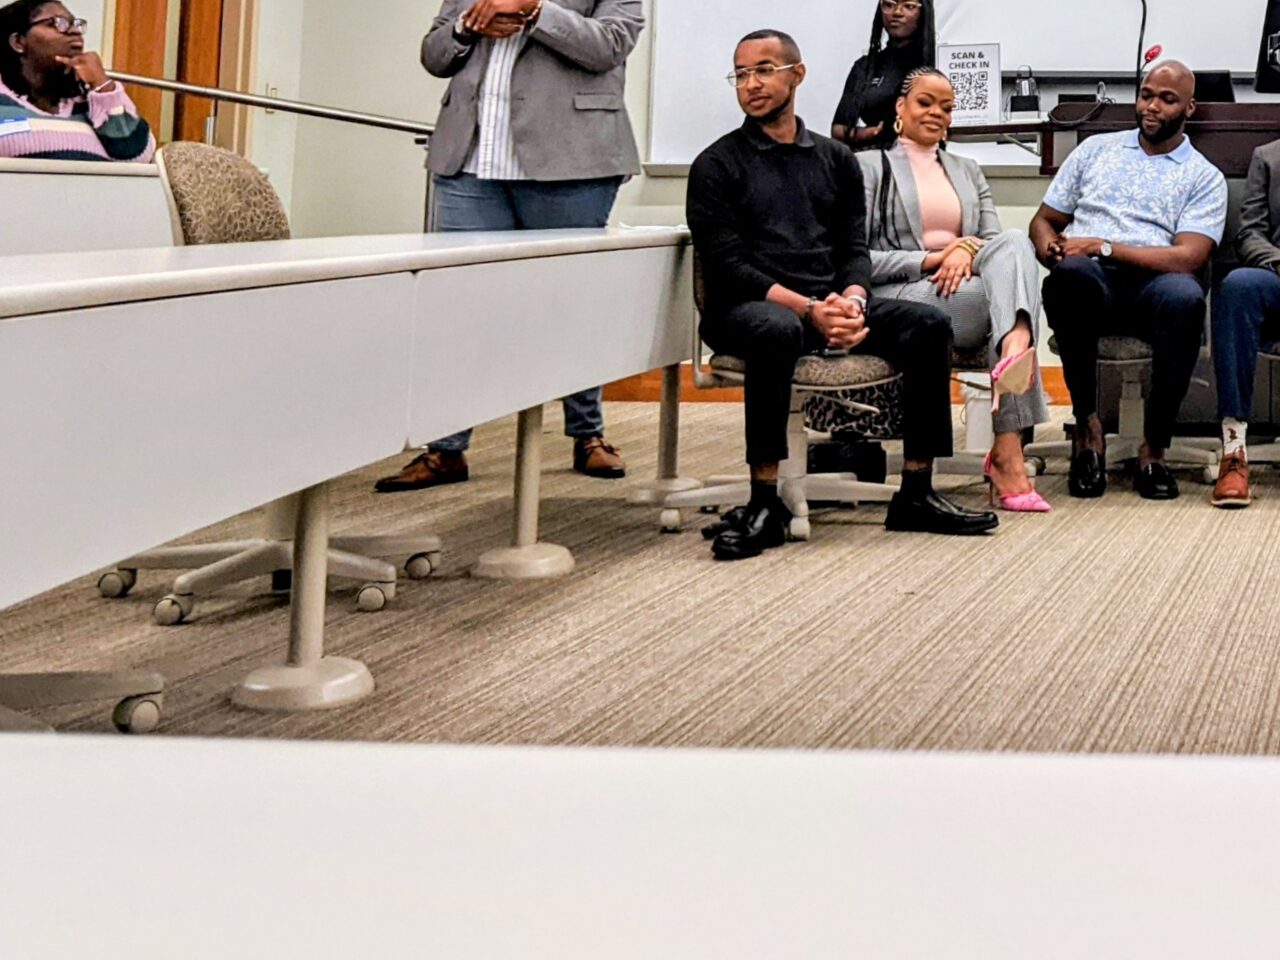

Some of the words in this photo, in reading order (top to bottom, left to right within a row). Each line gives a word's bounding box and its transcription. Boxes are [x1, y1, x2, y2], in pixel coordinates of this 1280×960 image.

[951, 51, 976, 60] SCAN
[977, 51, 985, 59] &
[949, 61, 978, 69] CHECK
[980, 60, 990, 68] IN
